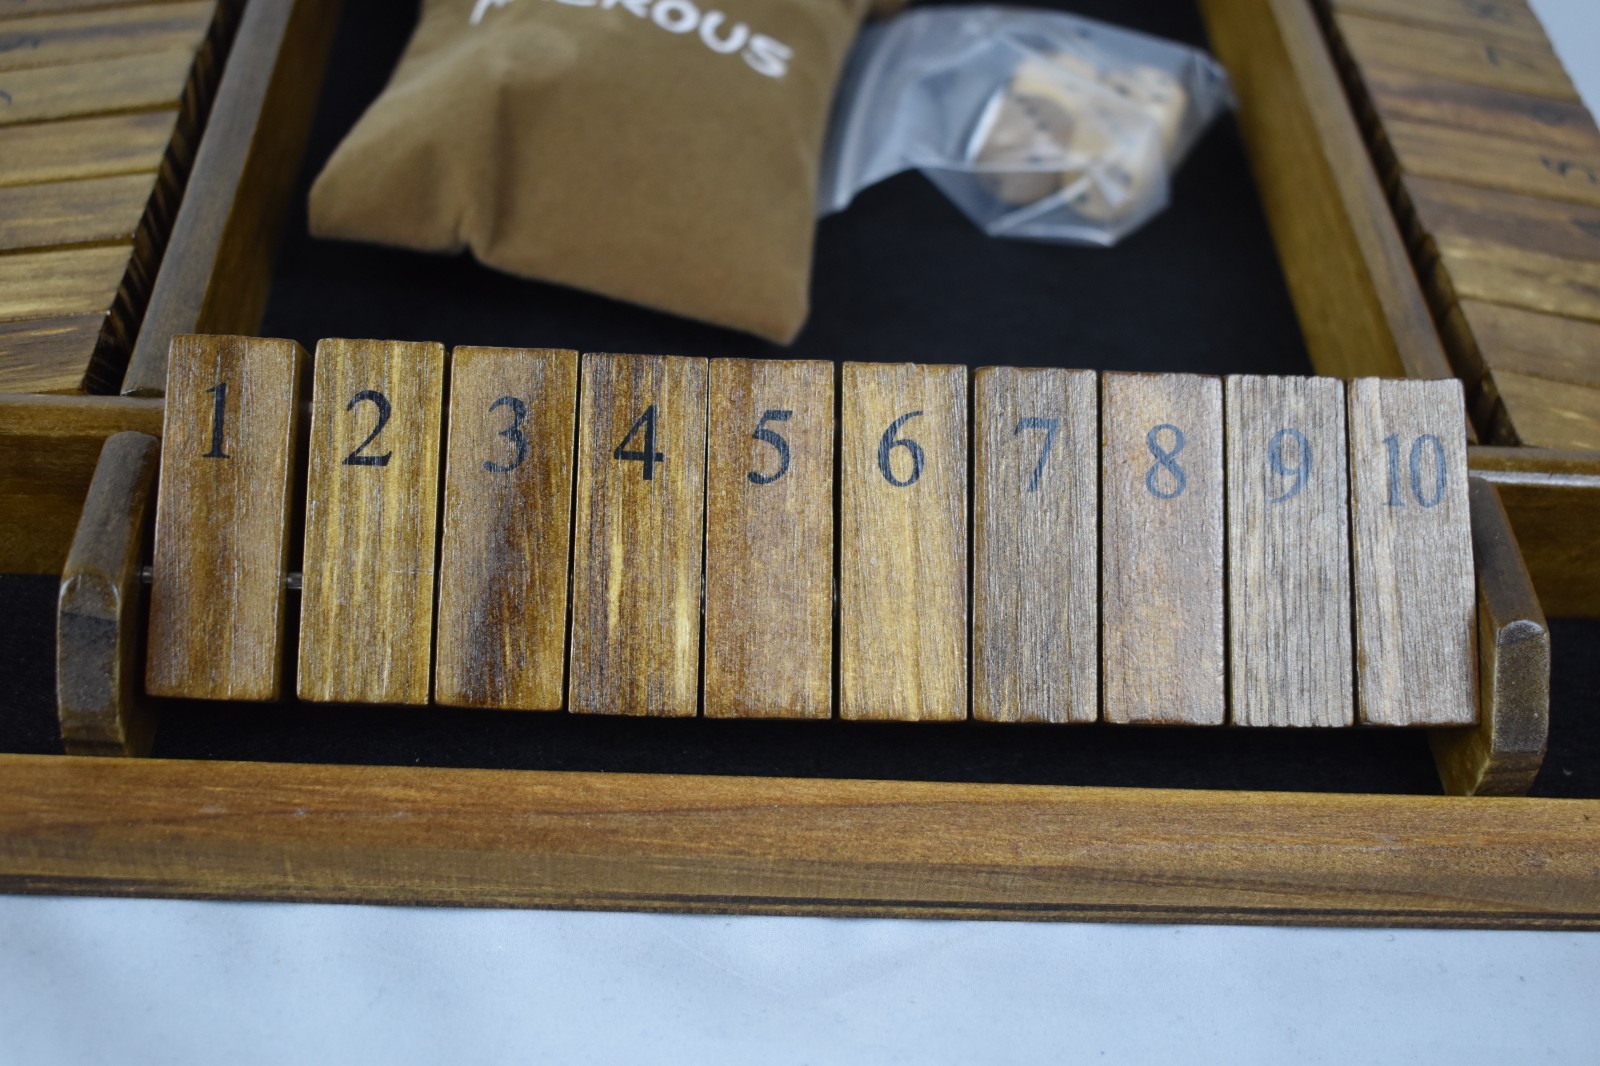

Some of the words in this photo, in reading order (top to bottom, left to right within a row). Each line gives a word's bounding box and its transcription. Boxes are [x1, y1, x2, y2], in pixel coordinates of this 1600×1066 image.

[201, 382, 231, 460] 1
[341, 390, 393, 467] 2
[483, 396, 529, 473] 3
[614, 404, 664, 480] 4
[747, 409, 793, 485] 5
[877, 410, 925, 487] 6
[1013, 416, 1060, 492] 7
[1145, 423, 1187, 499] 8
[1268, 427, 1312, 502] 9
[1381, 433, 1447, 508] 10
